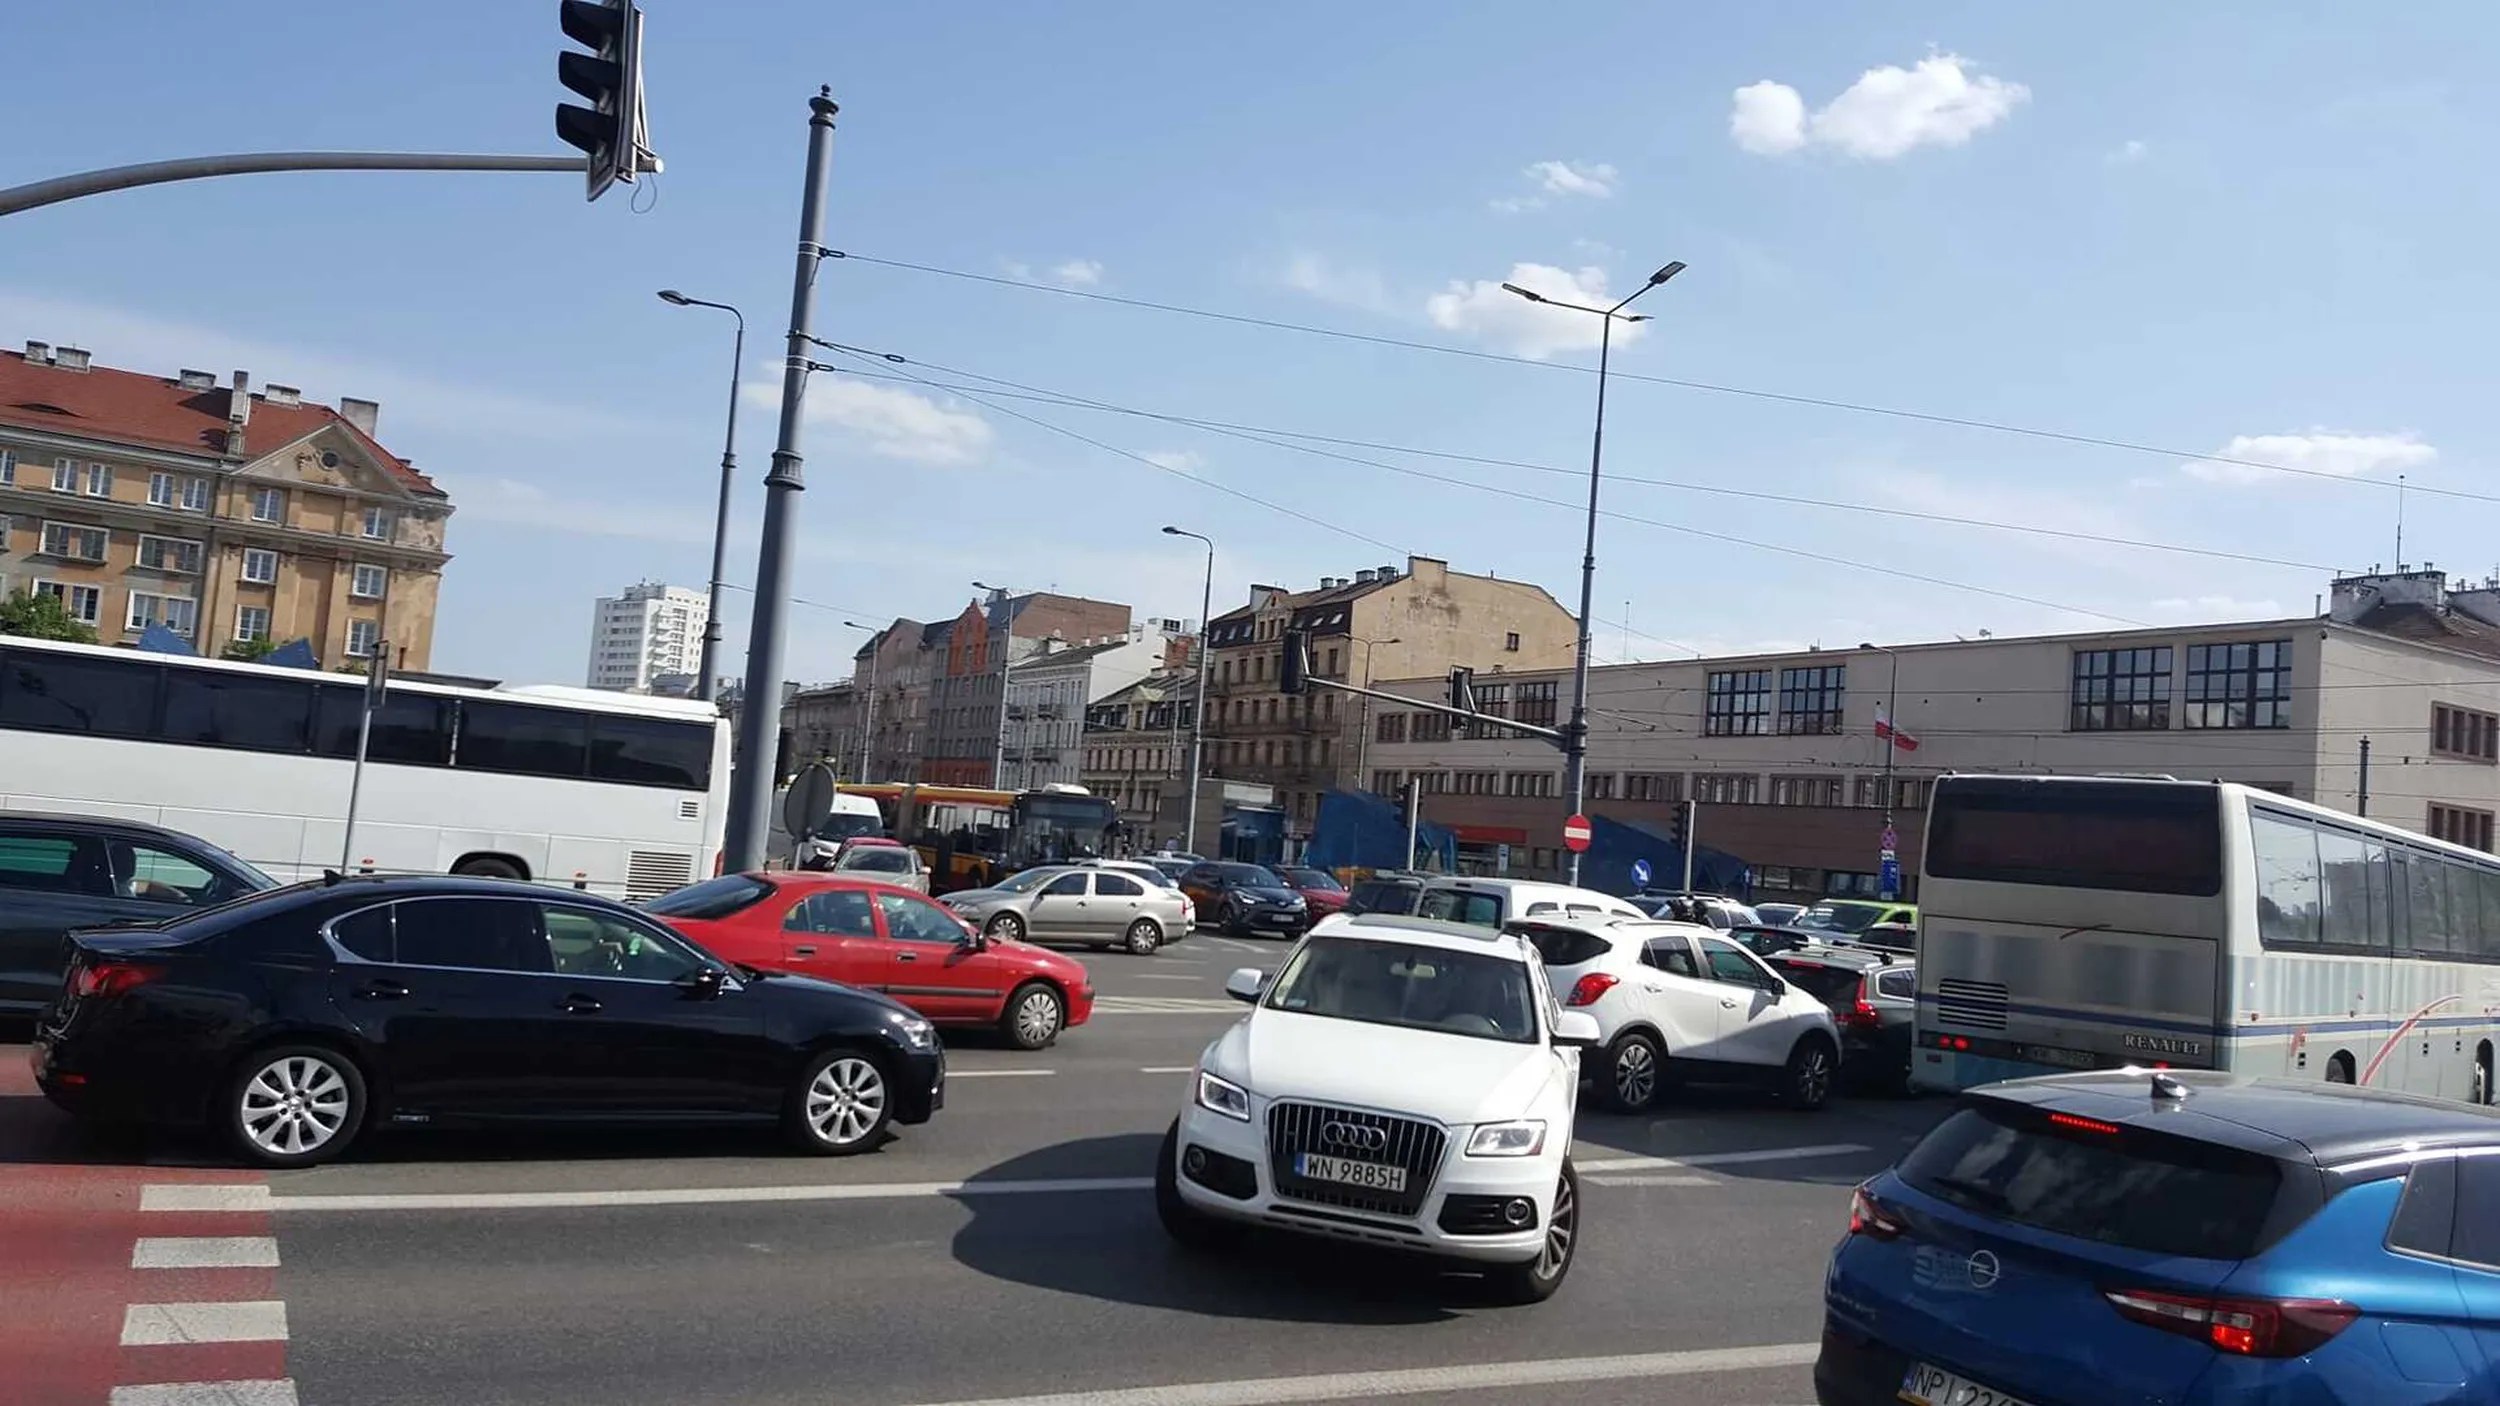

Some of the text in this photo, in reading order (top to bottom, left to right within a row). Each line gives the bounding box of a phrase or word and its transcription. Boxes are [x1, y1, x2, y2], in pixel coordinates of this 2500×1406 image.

[2124, 1034, 2200, 1055] RENAULT
[1307, 1155, 1402, 1189] WN 9885H
